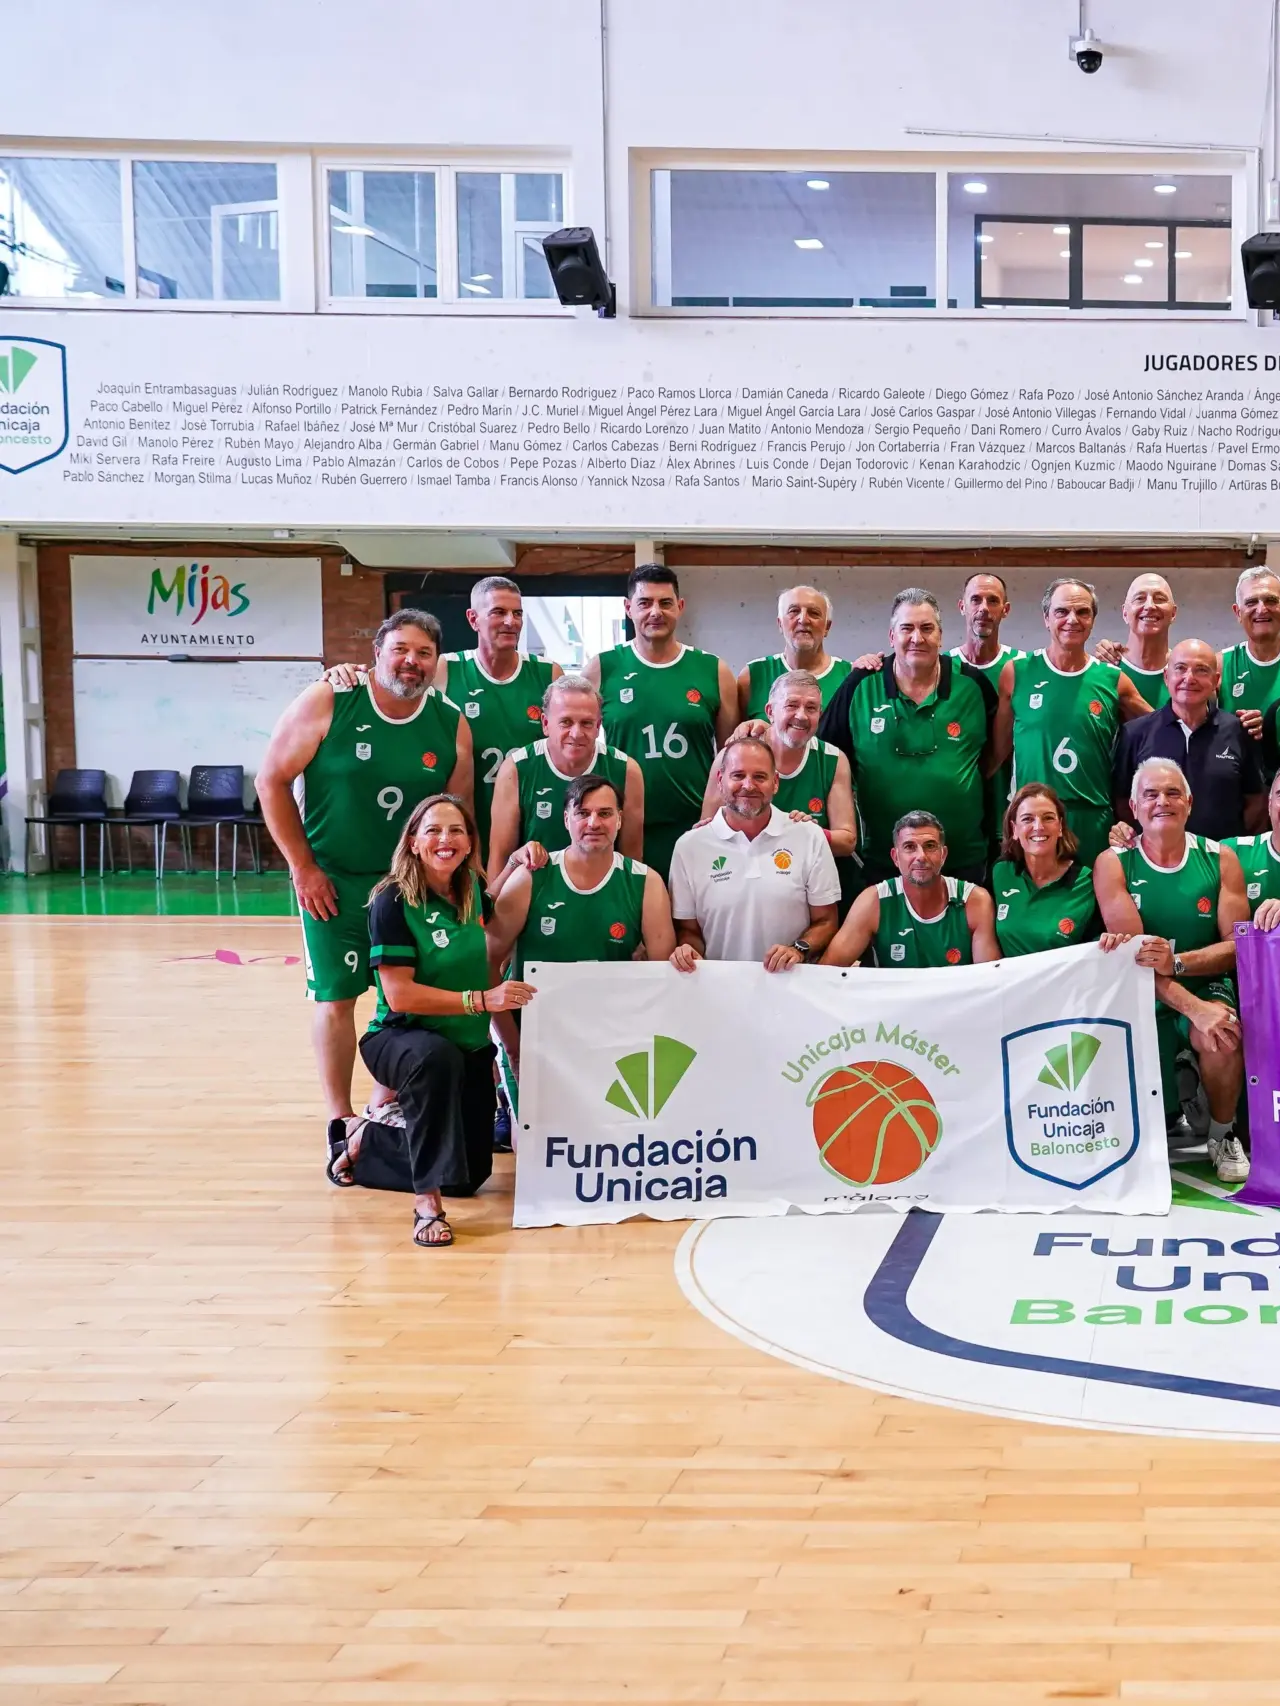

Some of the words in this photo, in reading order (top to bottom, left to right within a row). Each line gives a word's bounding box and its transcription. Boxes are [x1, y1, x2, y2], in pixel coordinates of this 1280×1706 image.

[1144, 355, 1257, 371] JUGADORES
[348, 383, 388, 397] Manolo
[391, 384, 424, 398] Rubia
[431, 384, 463, 398] Salva
[464, 385, 500, 398] Gallar
[627, 386, 656, 399] Paco
[655, 386, 696, 400] Ramos
[698, 386, 732, 400] Llorca
[837, 387, 880, 401] Ricardo
[882, 387, 925, 401] Galeote
[1017, 388, 1046, 401] Rafa
[1046, 388, 1075, 401] Pozo
[0, 401, 49, 415] dación
[90, 399, 119, 413] Paco
[118, 399, 163, 413] Cabello
[251, 401, 292, 415] Alfonso
[295, 401, 332, 415] Portillo
[521, 403, 544, 417] J.C.
[544, 403, 579, 417] Muriel
[1106, 406, 1158, 419] Fernando
[1157, 406, 1188, 419] Vidal
[0, 418, 40, 434] nicaja
[527, 421, 560, 434] Pedro
[561, 421, 592, 434] Bello
[599, 421, 645, 435] Ricardo
[645, 421, 689, 435] Lorenzo
[769, 422, 814, 436] Antonio
[813, 422, 866, 436] Mendoza
[970, 423, 998, 436] Dani
[998, 423, 1044, 436] Romero
[1130, 423, 1161, 440] Gaby
[1161, 423, 1189, 437] Ruiz
[303, 436, 356, 453] Alejandro
[356, 436, 384, 450] Alba
[571, 438, 608, 452] Carlos
[610, 438, 661, 452] Cabezas
[767, 439, 810, 453] Francis
[810, 439, 847, 456] Perujo
[1136, 441, 1165, 454] Rafa
[1165, 441, 1210, 454] Huertas
[1216, 441, 1248, 454] Pavel
[151, 452, 181, 466] Rafa
[180, 453, 216, 466] Freire
[223, 453, 271, 469] Augusto
[275, 453, 304, 467] Lima
[507, 455, 541, 472] Pepe
[541, 455, 578, 469] Pozas
[744, 457, 770, 470] Luis
[770, 457, 809, 470] Conde
[817, 457, 851, 473] Dejan
[855, 457, 908, 471] Todorovic
[918, 457, 958, 471] Kenan
[958, 458, 1023, 472] Karahodzic
[1029, 458, 1073, 474] Ognjen
[1072, 458, 1117, 472] Kuzmic
[1123, 458, 1165, 472] Maodo
[1166, 458, 1216, 475] Nguirane
[1227, 459, 1269, 472] Domas
[154, 470, 197, 486] Morgan
[197, 470, 233, 484] Stilma
[415, 472, 452, 486] Ismael
[453, 472, 492, 486] Tamba
[500, 473, 540, 486] Francis
[540, 473, 577, 487] Alonso
[585, 473, 628, 487] Yannick
[631, 473, 665, 487] Nzosa
[675, 474, 700, 487] Rafa
[700, 474, 740, 488] Santos
[1055, 476, 1108, 490] Baboucar
[1108, 477, 1137, 493] Badji
[1146, 477, 1177, 490] Manu
[1178, 477, 1218, 493] Trujillo
[147, 563, 250, 626] Mijas
[140, 634, 255, 645] AYUNTAMIENTO
[641, 721, 689, 759] 16
[1052, 736, 1078, 774] 6
[376, 785, 404, 821] 9
[344, 950, 359, 973] 9
[781, 1025, 866, 1083] Unicaja
[875, 1021, 960, 1076] Máster
[1028, 1097, 1115, 1119] Fundación
[1043, 1120, 1105, 1139] Unicaja
[545, 1128, 757, 1168] Fundación
[1030, 1137, 1121, 1156] Baloncesto
[575, 1167, 728, 1202] Unicaja
